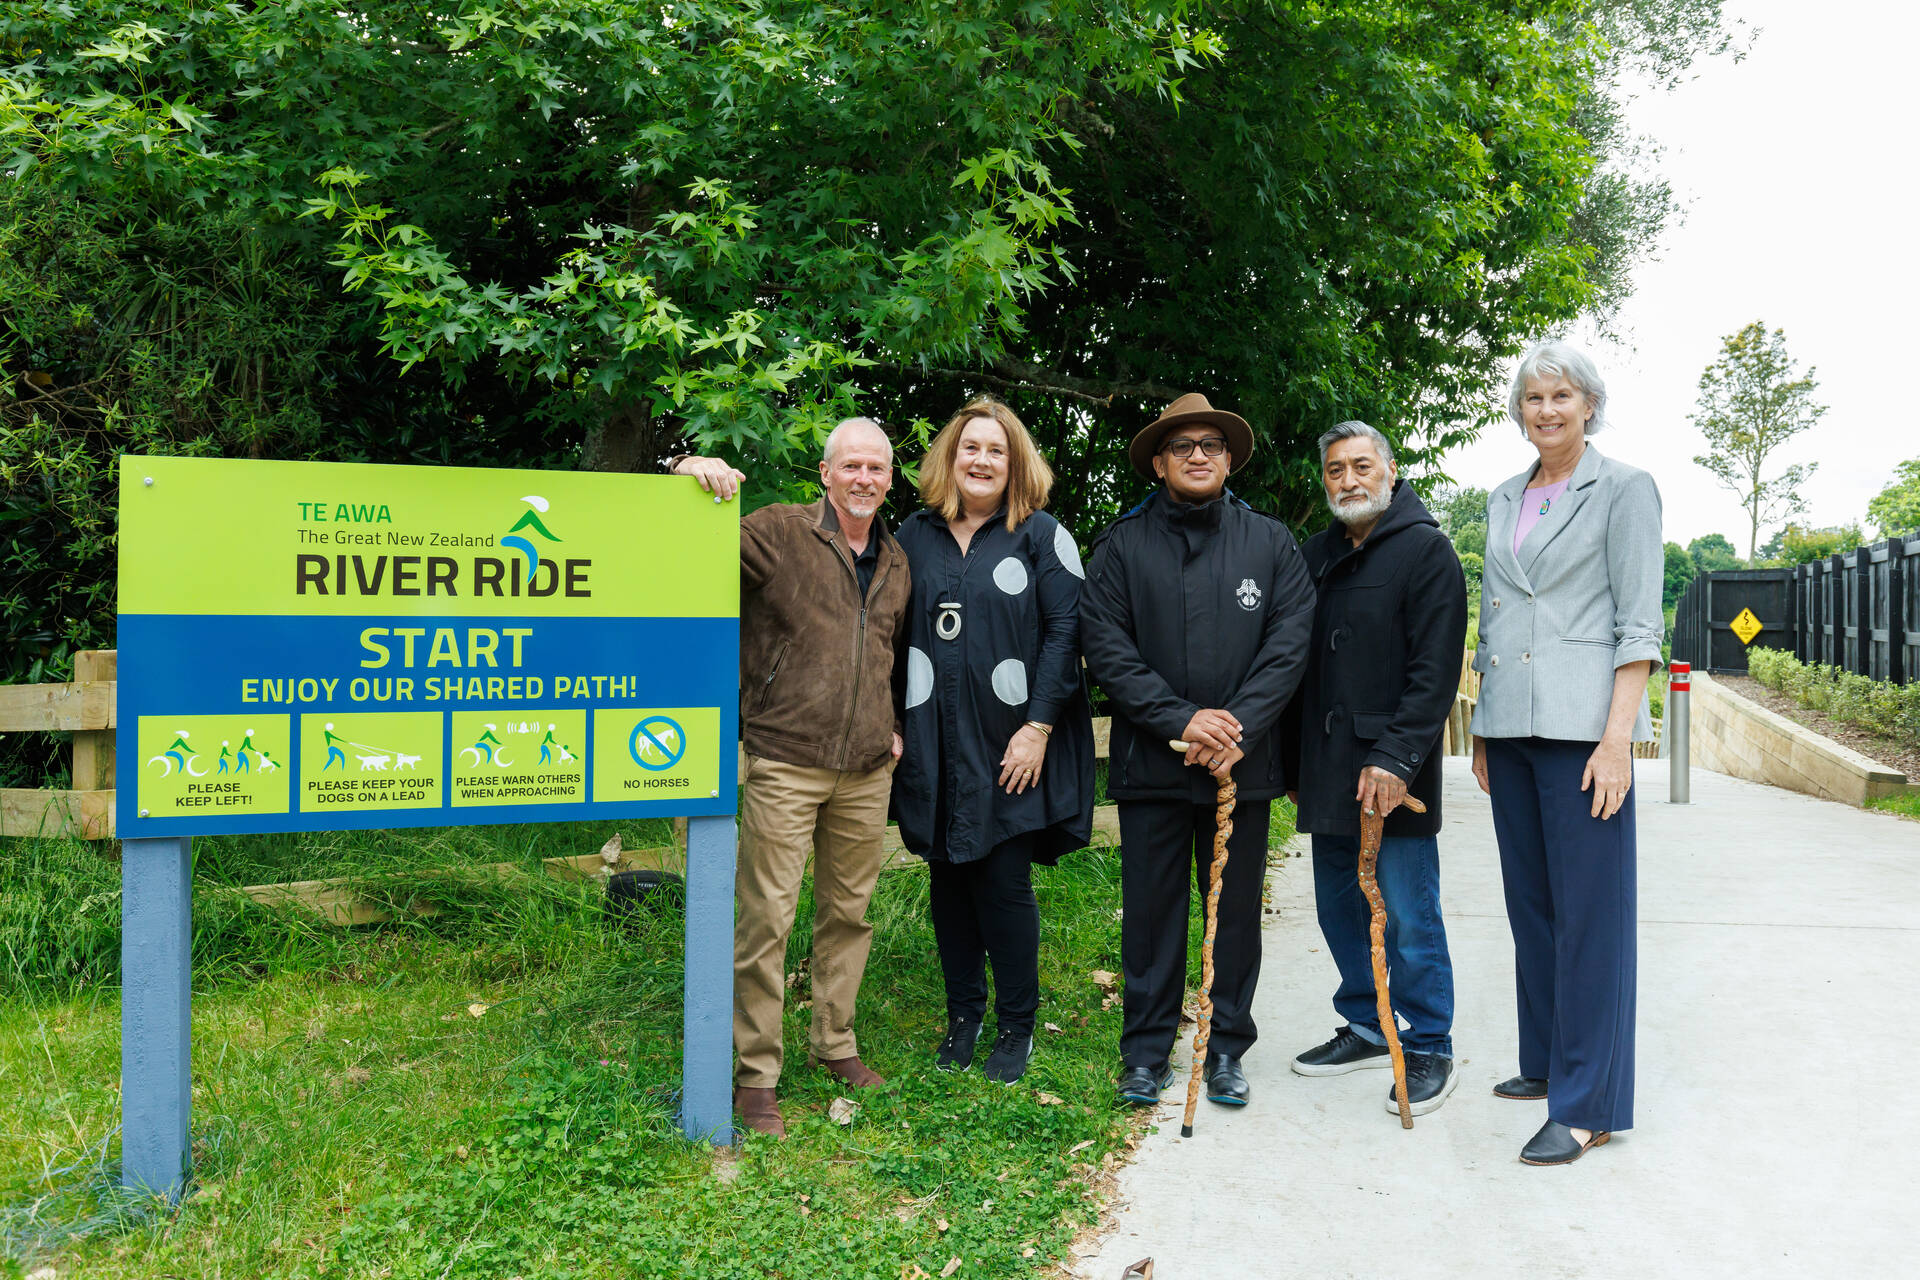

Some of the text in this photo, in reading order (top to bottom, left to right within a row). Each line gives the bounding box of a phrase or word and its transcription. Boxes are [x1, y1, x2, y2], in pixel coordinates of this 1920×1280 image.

[298, 502, 392, 523] TE AWA
[298, 529, 494, 547] The Great New Zealand
[296, 554, 592, 598] RIVER RIDE
[360, 627, 533, 669] START
[242, 676, 637, 704] ENJOY OUR SHARED PATH!
[308, 778, 434, 791] PLEASE KEEP YOUR
[456, 774, 581, 786] PLEASE WARN OTHERS
[624, 778, 690, 789] NO HORSES
[188, 782, 241, 793] PLEASE
[461, 786, 576, 798] WHEN APPROACHING
[176, 795, 252, 807] KEEP LEFT!
[317, 791, 425, 803] DOGS ON A LEAD
